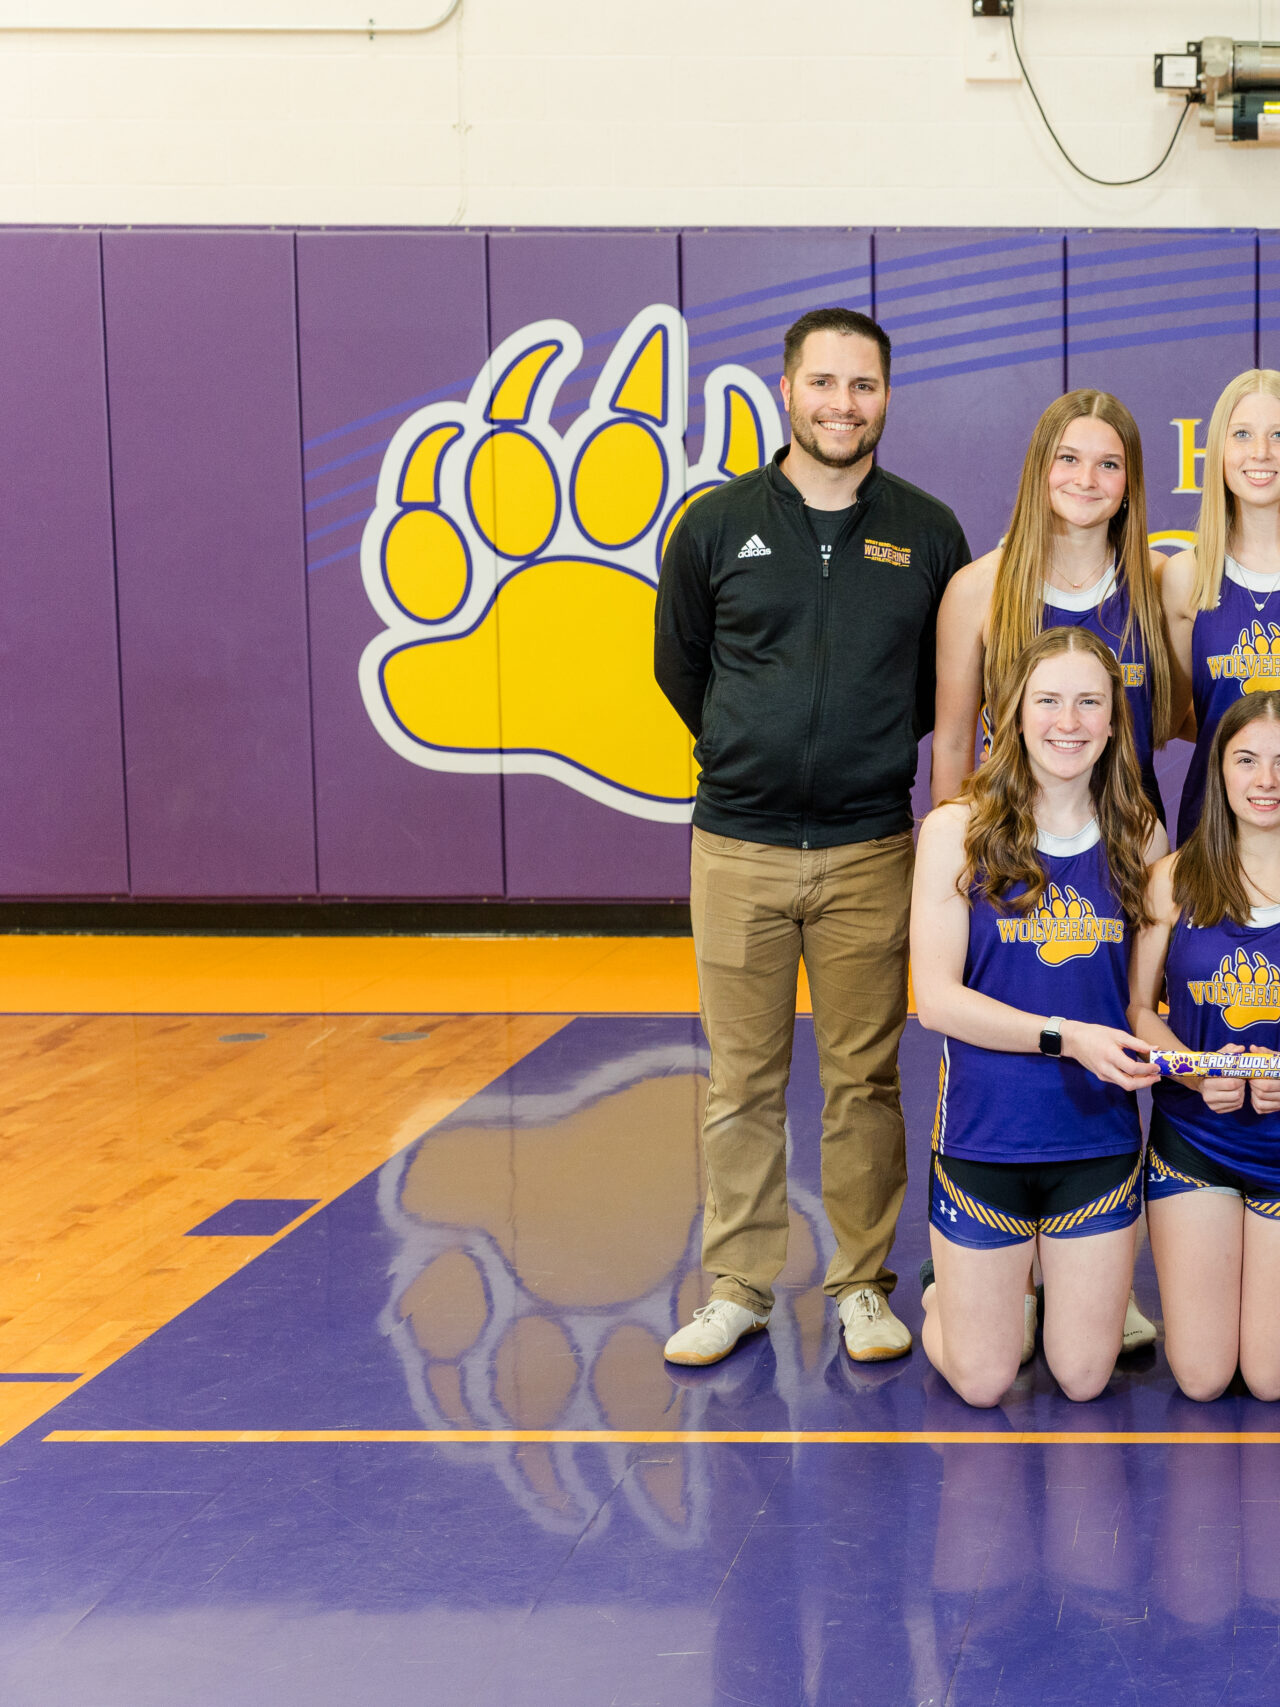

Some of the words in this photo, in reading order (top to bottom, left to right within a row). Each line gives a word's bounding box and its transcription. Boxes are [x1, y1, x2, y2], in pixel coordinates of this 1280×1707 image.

[737, 547, 772, 559] adidas
[864, 543, 911, 564] WOLVERINE
[996, 918, 1125, 943] WOLVERINES
[1199, 1055, 1234, 1068] LADY
